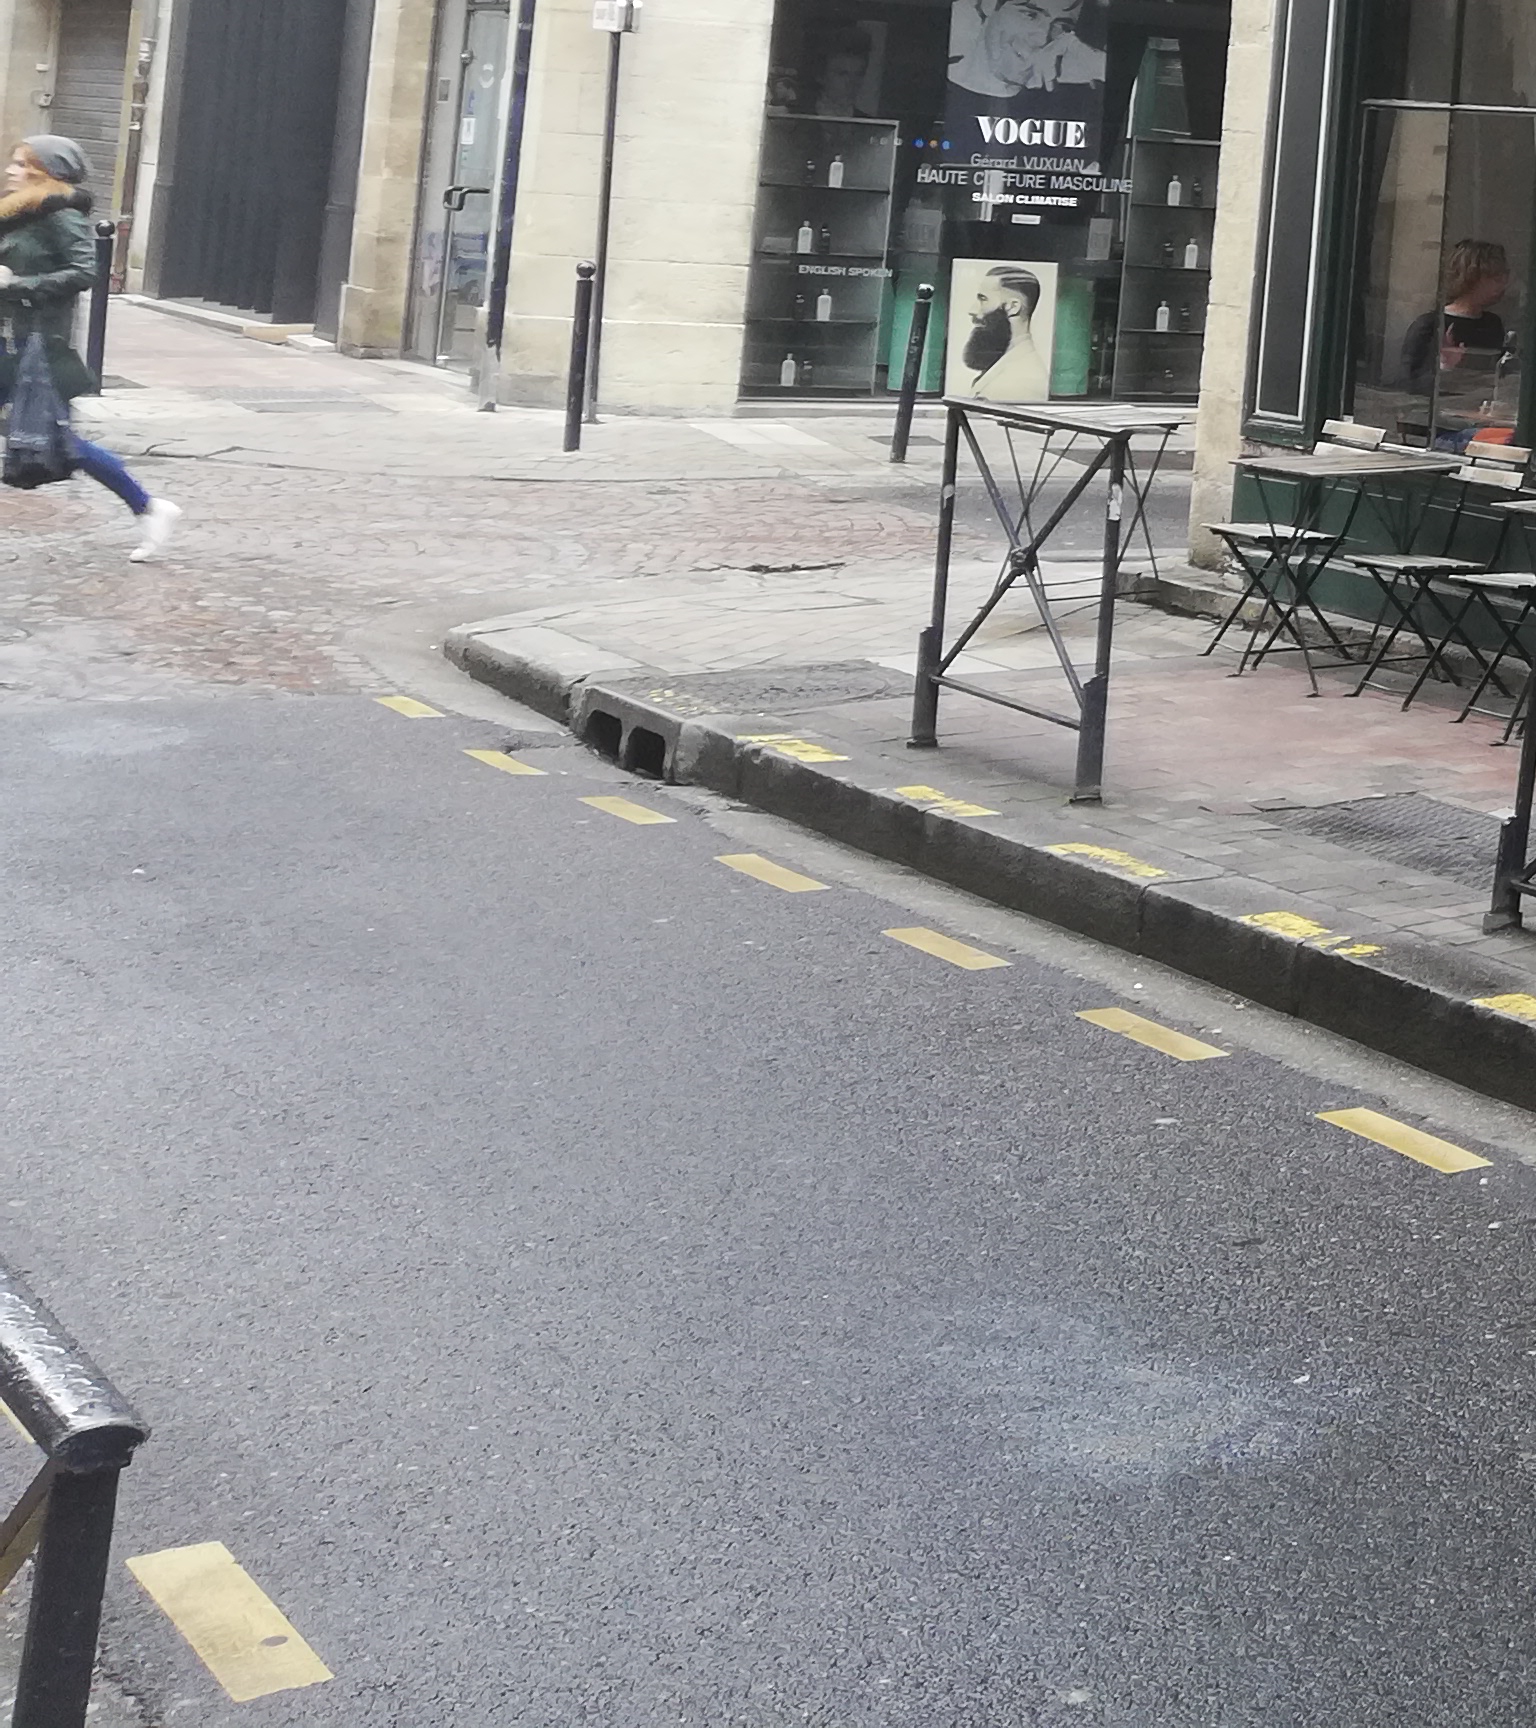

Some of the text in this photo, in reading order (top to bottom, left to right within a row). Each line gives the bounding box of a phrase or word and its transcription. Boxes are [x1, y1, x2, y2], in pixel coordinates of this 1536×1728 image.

[974, 115, 1087, 148] VOGUE
[970, 153, 1084, 172] Gérard VUXUAN
[917, 168, 969, 185] HAUTE
[1050, 175, 1133, 193] MASCULINE
[972, 192, 1077, 207] SALON CLIMATISE
[798, 264, 893, 277] ENGLISH SPOKEN
